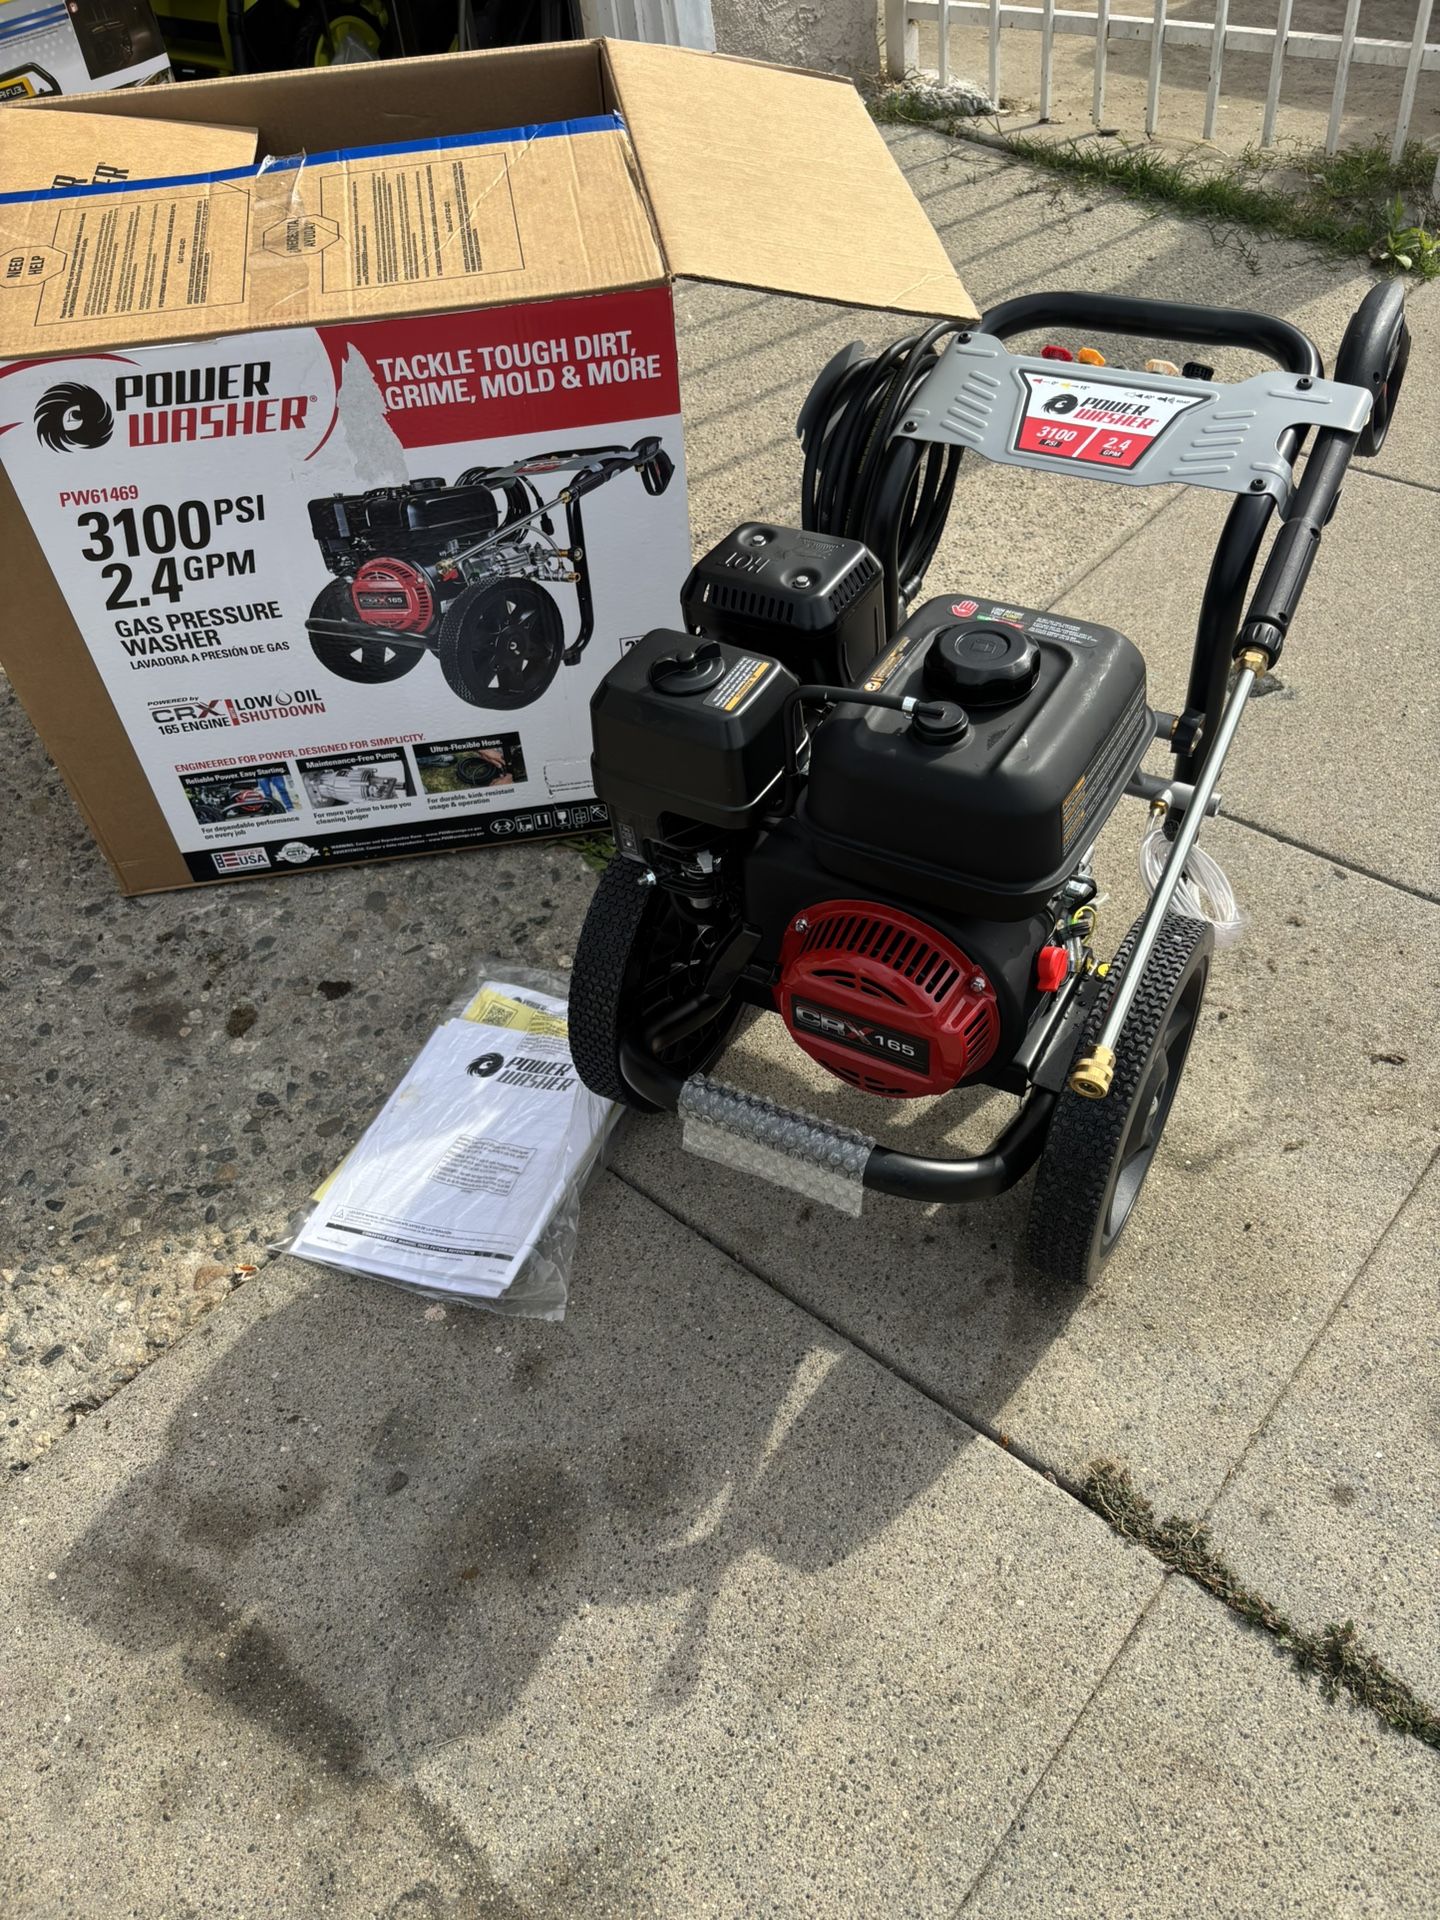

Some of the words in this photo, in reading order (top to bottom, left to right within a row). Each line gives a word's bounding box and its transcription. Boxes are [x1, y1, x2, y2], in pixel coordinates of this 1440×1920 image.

[6, 256, 24, 278] NEED
[28, 255, 45, 275] HELP
[376, 350, 476, 383] TACKLE
[477, 339, 568, 371] TOUGH
[574, 330, 637, 361] DIRT,
[115, 361, 271, 411] POWER
[384, 378, 477, 411] GRIME,
[480, 368, 555, 399] MOLD
[561, 364, 582, 390] &
[587, 354, 662, 386] MORE
[1079, 397, 1151, 416] POWER
[1036, 425, 1078, 441] 3100
[1044, 439, 1058, 447] PSI
[1102, 436, 1132, 451] 2.4
[1102, 449, 1124, 458] GPM
[59, 484, 140, 508] PW61469
[77, 500, 211, 561] 3100
[213, 494, 265, 526] PSI
[720, 552, 770, 574] HOT
[101, 556, 184, 611] 2.4
[183, 549, 256, 581] GPM
[114, 616, 165, 637] GAS
[165, 601, 283, 632] PRESSURE
[120, 629, 222, 657] WASHER
[130, 652, 190, 670] LAVADORA
[191, 652, 200, 662] A
[201, 646, 250, 662] PRESIÓN
[251, 645, 265, 655] DE
[266, 641, 290, 653] GAS
[147, 697, 188, 707] POWERED
[234, 695, 273, 711] LOW
[294, 688, 322, 703] OIL
[151, 699, 226, 724] CRX
[239, 702, 326, 724] SHUTDOWN
[158, 725, 180, 735] 165
[181, 717, 231, 733] ENGINE
[174, 757, 237, 773] ENGINEERED
[238, 754, 258, 764] FOR
[298, 743, 348, 757] DESIGNED
[349, 740, 369, 750] FOR
[370, 733, 426, 747] SIMPLICITY.
[429, 741, 481, 754] Ultra-Flexible
[305, 755, 375, 769] Maintenance-Free
[376, 751, 400, 760] Pump.
[185, 776, 215, 785] Reliable
[467, 788, 515, 799] kink-resistant
[326, 810, 344, 818] more
[345, 806, 372, 815] up-time
[380, 802, 398, 811] keep
[428, 803, 449, 811] usage
[458, 798, 491, 807] operation
[214, 822, 255, 833] dependable
[256, 816, 300, 828] performance
[316, 816, 347, 826] cleaning
[347, 813, 369, 823] longer
[215, 832, 234, 840] every
[235, 829, 247, 838] job
[239, 854, 268, 866] USA
[795, 1005, 876, 1046] CRX
[874, 1035, 916, 1057] 165
[504, 1056, 574, 1077] POWER
[496, 1070, 577, 1092] WASHER
